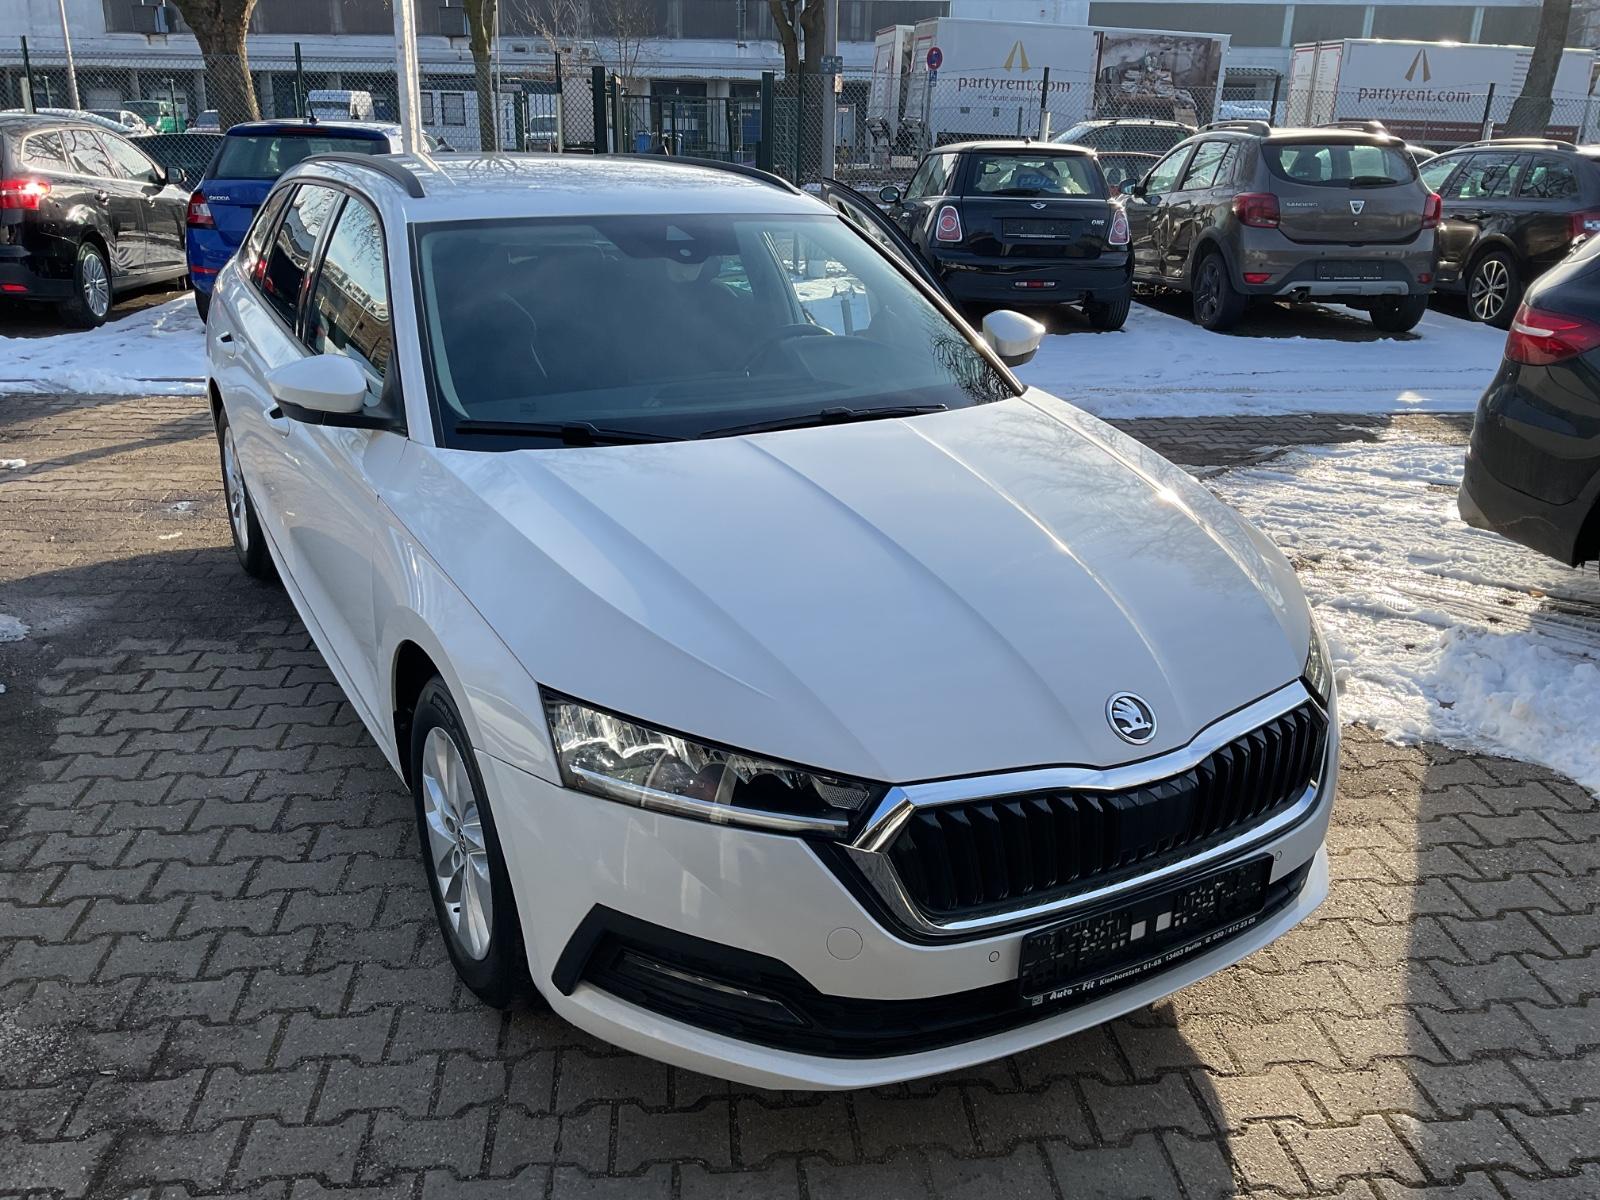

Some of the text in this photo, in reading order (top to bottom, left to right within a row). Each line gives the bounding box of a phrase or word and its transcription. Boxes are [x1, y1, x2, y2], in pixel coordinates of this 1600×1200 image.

[958, 77, 1071, 93] partyrent.com
[1358, 87, 1471, 104] partyrent.com
[1049, 990, 1073, 1000] Auto
[1082, 981, 1096, 991] Fit
